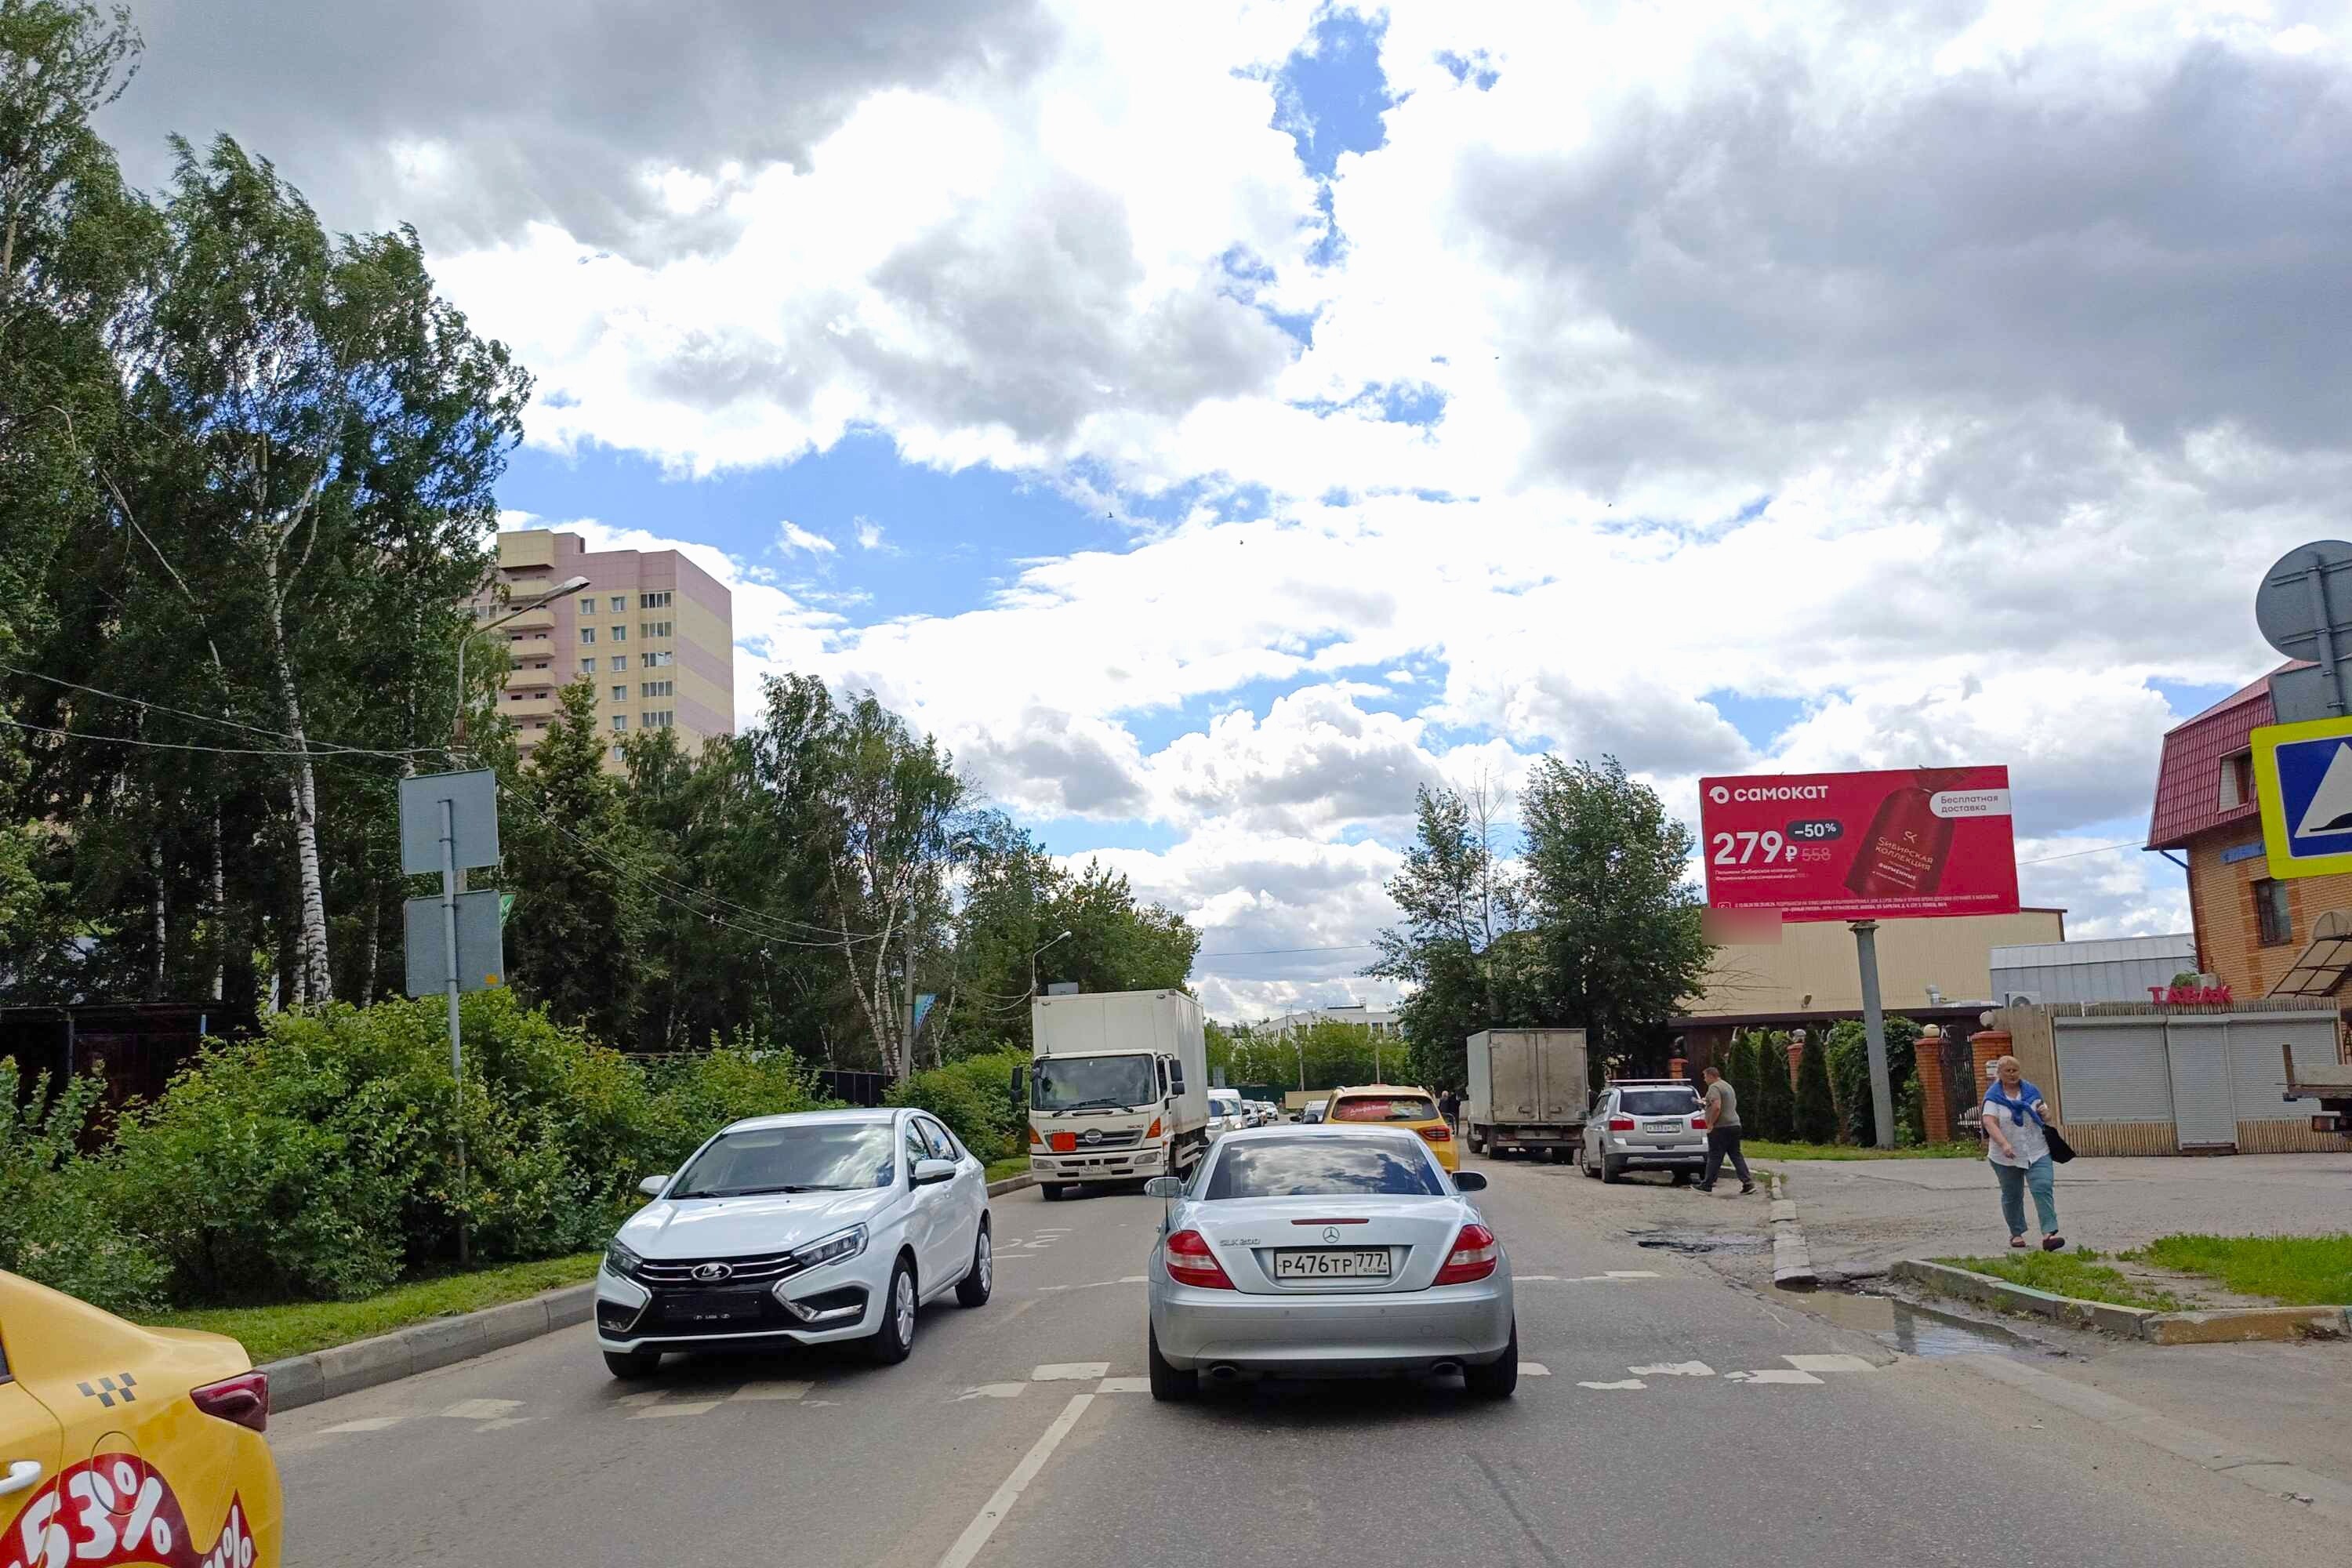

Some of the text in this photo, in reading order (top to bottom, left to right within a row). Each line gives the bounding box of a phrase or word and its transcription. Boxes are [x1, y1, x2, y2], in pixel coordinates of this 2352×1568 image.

[1733, 785, 1829, 802] самокат
[1940, 795, 1998, 804] Бесплатная
[1941, 804, 1987, 813] доставка
[2147, 985, 2234, 1004] ТАБАК
[1356, 1254, 1383, 1268] 777
